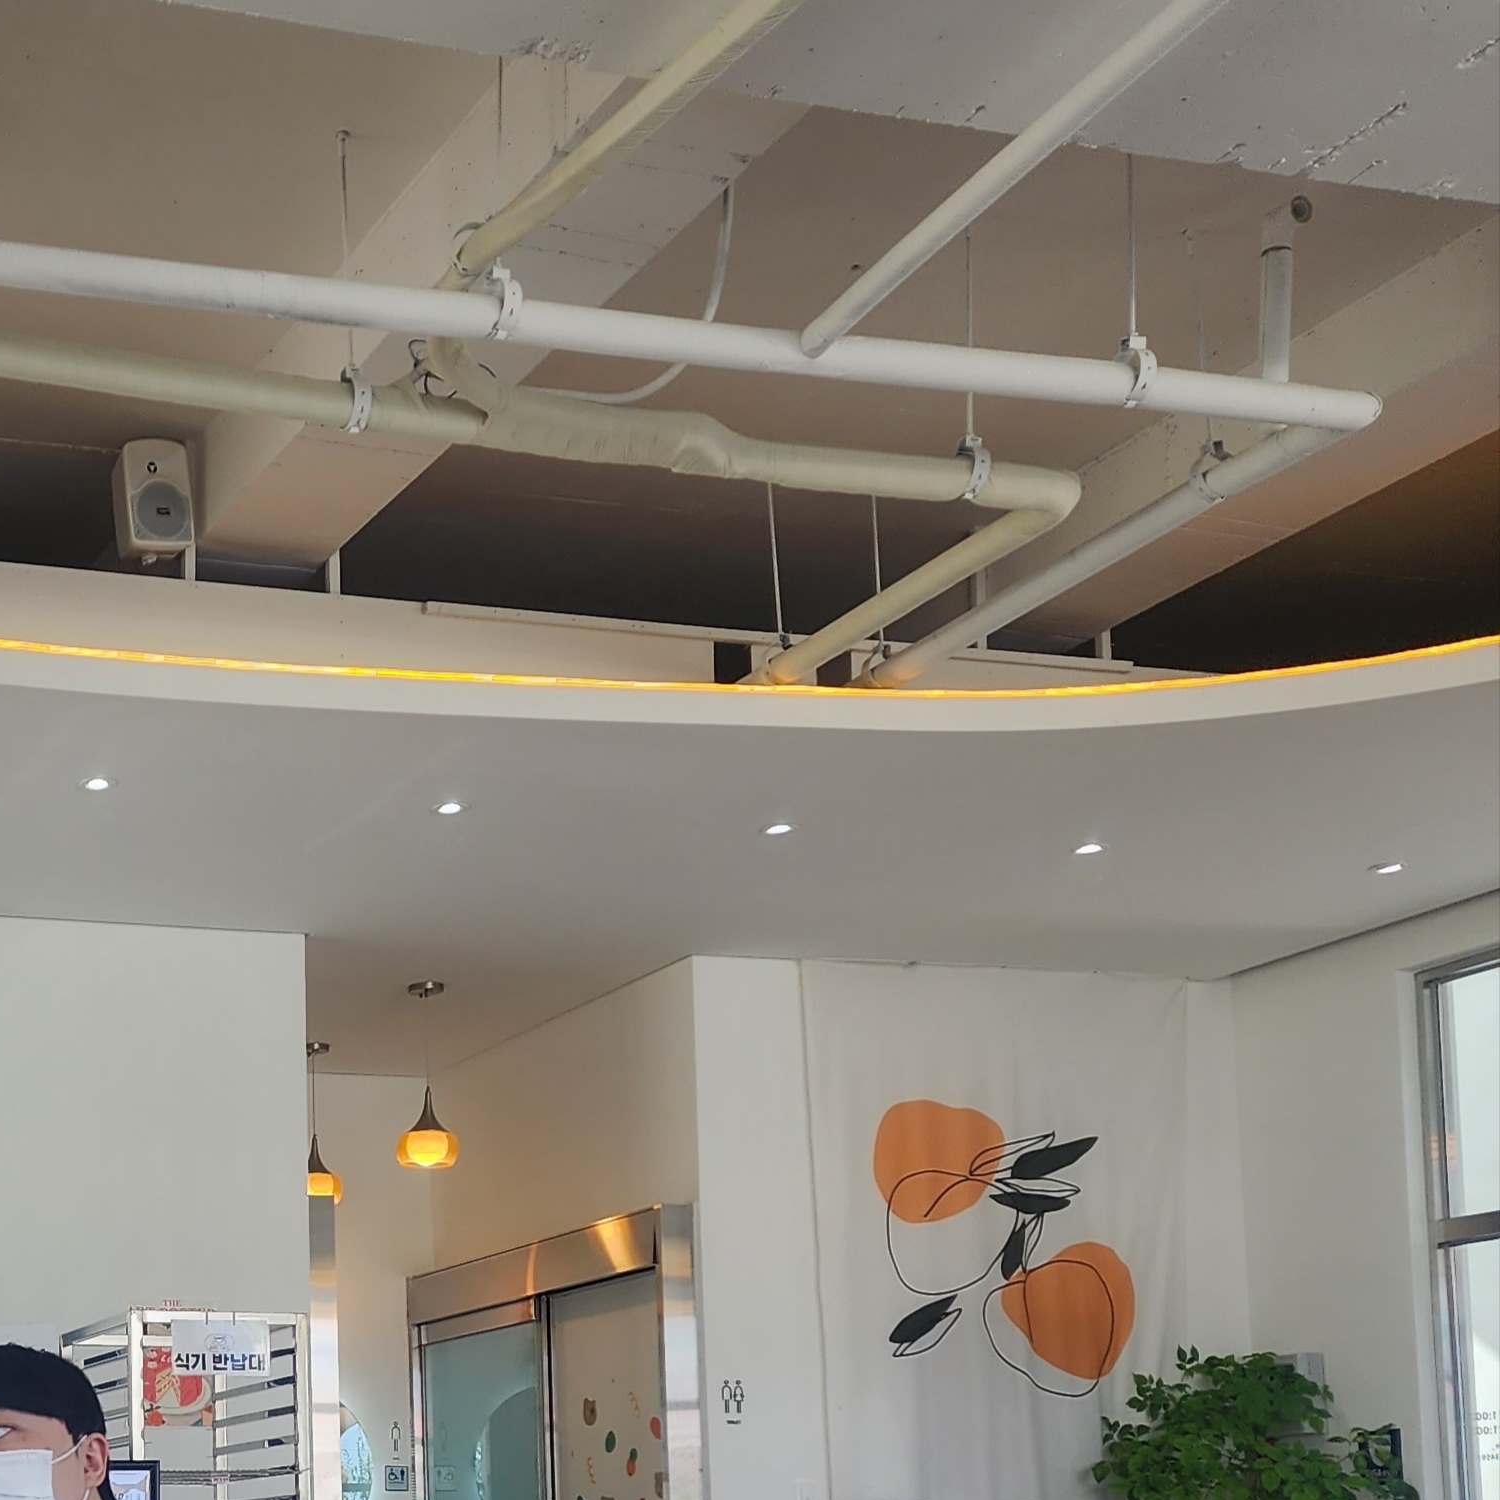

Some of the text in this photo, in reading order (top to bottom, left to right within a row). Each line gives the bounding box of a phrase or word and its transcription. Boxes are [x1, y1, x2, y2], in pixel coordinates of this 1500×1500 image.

[162, 1299, 182, 1307] THE
[174, 1352, 266, 1371] 식기 반납대
